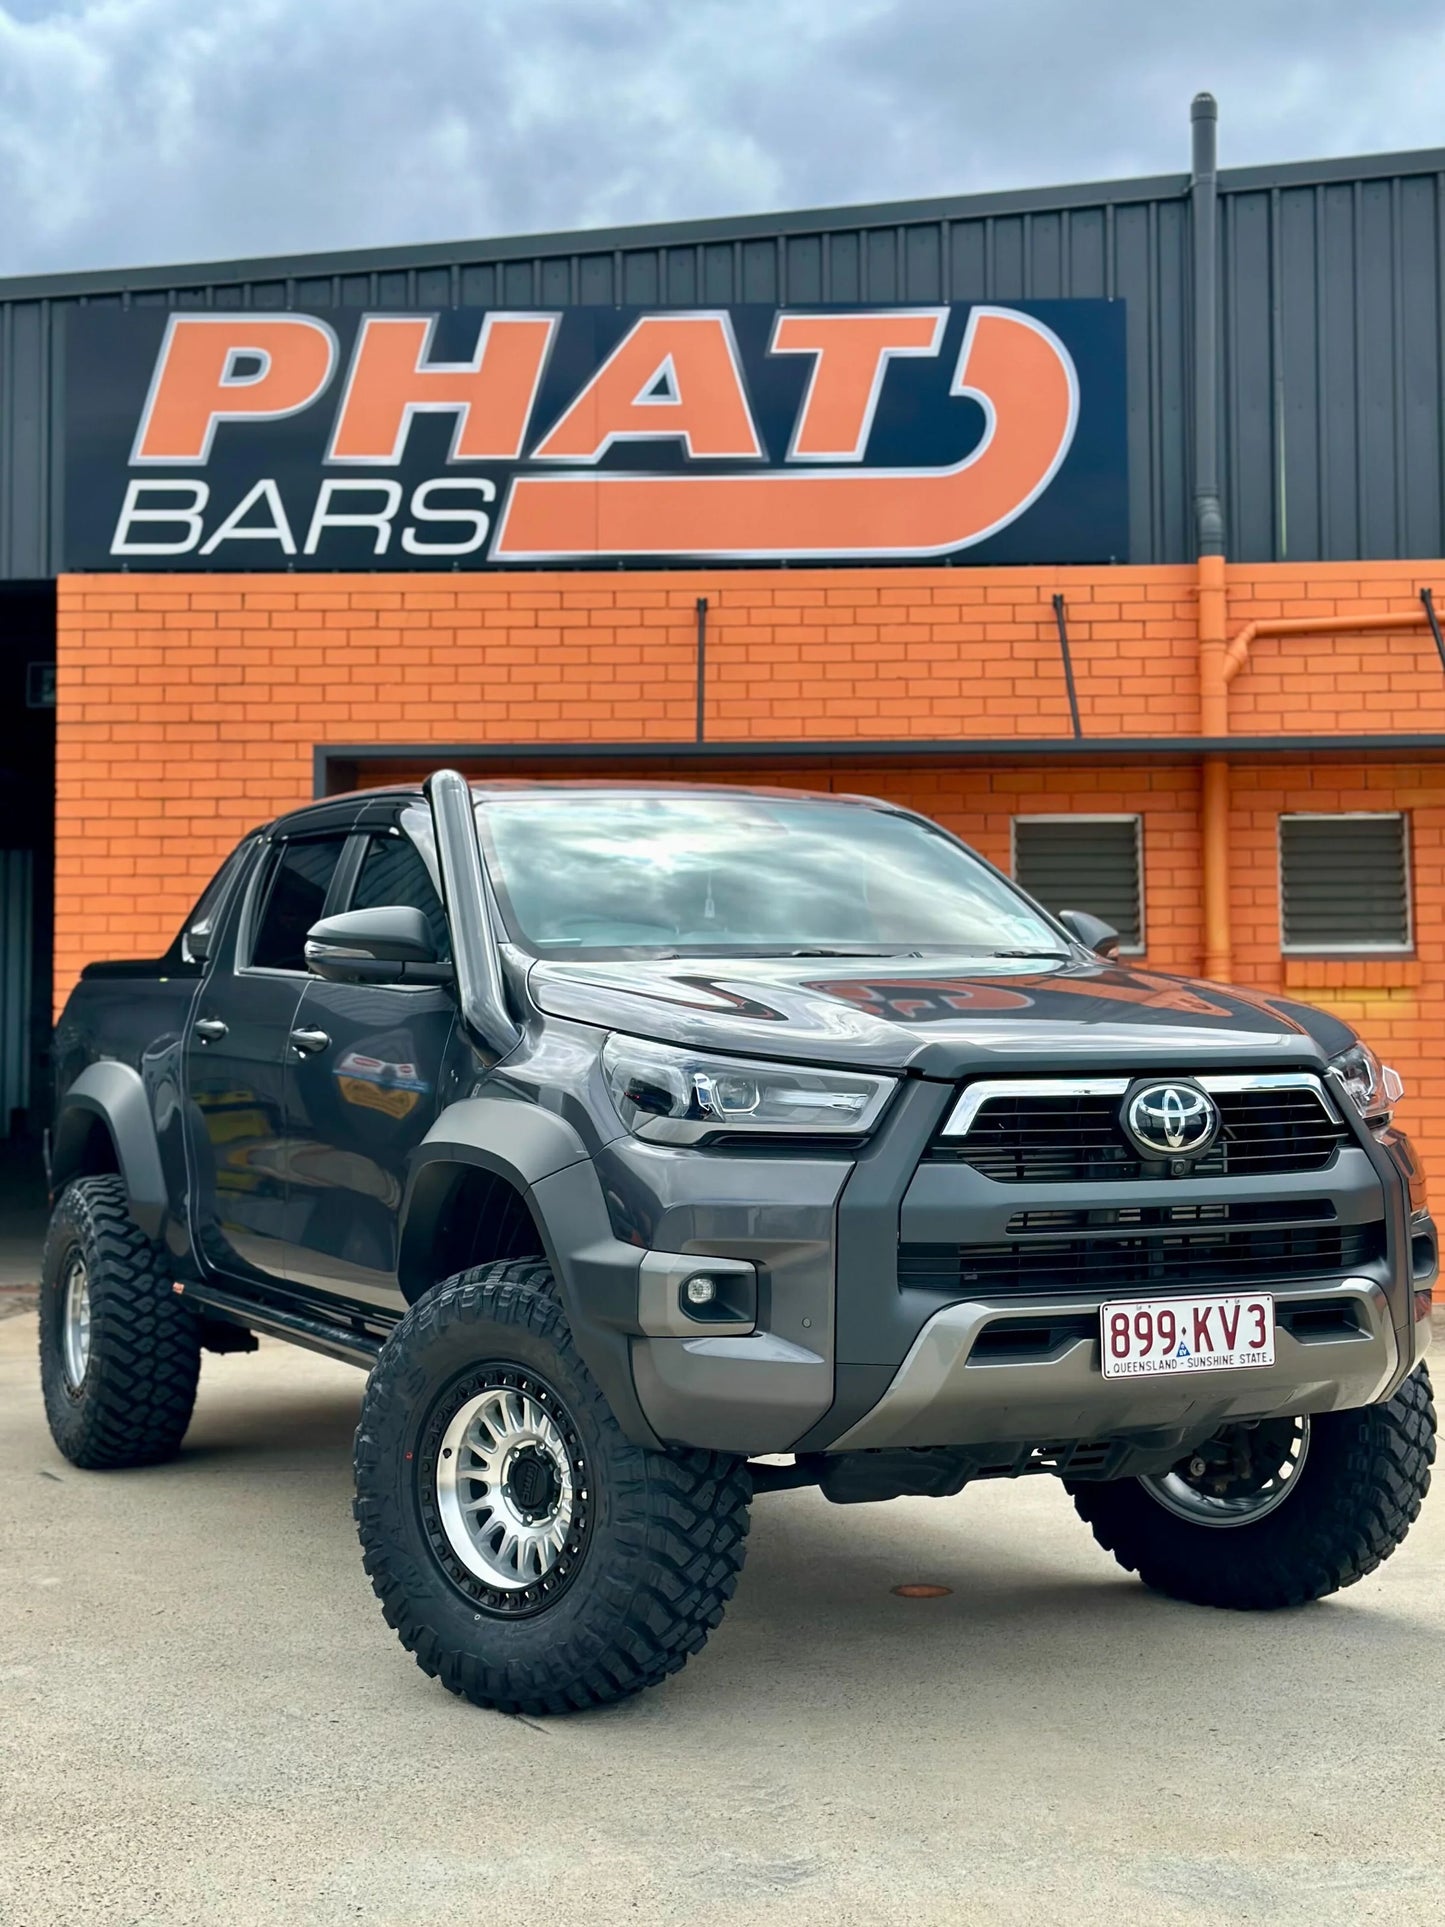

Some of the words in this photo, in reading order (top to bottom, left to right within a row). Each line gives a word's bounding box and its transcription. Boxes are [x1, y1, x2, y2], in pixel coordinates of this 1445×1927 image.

[128, 306, 951, 466] PHAT
[109, 477, 497, 555] BARS
[1110, 1309, 1176, 1358] 899
[1192, 1303, 1266, 1353] KV3
[1113, 1357, 1177, 1374] QUEENSLAND
[1187, 1353, 1235, 1368] SUNSHINE
[1239, 1351, 1267, 1364] STATE
